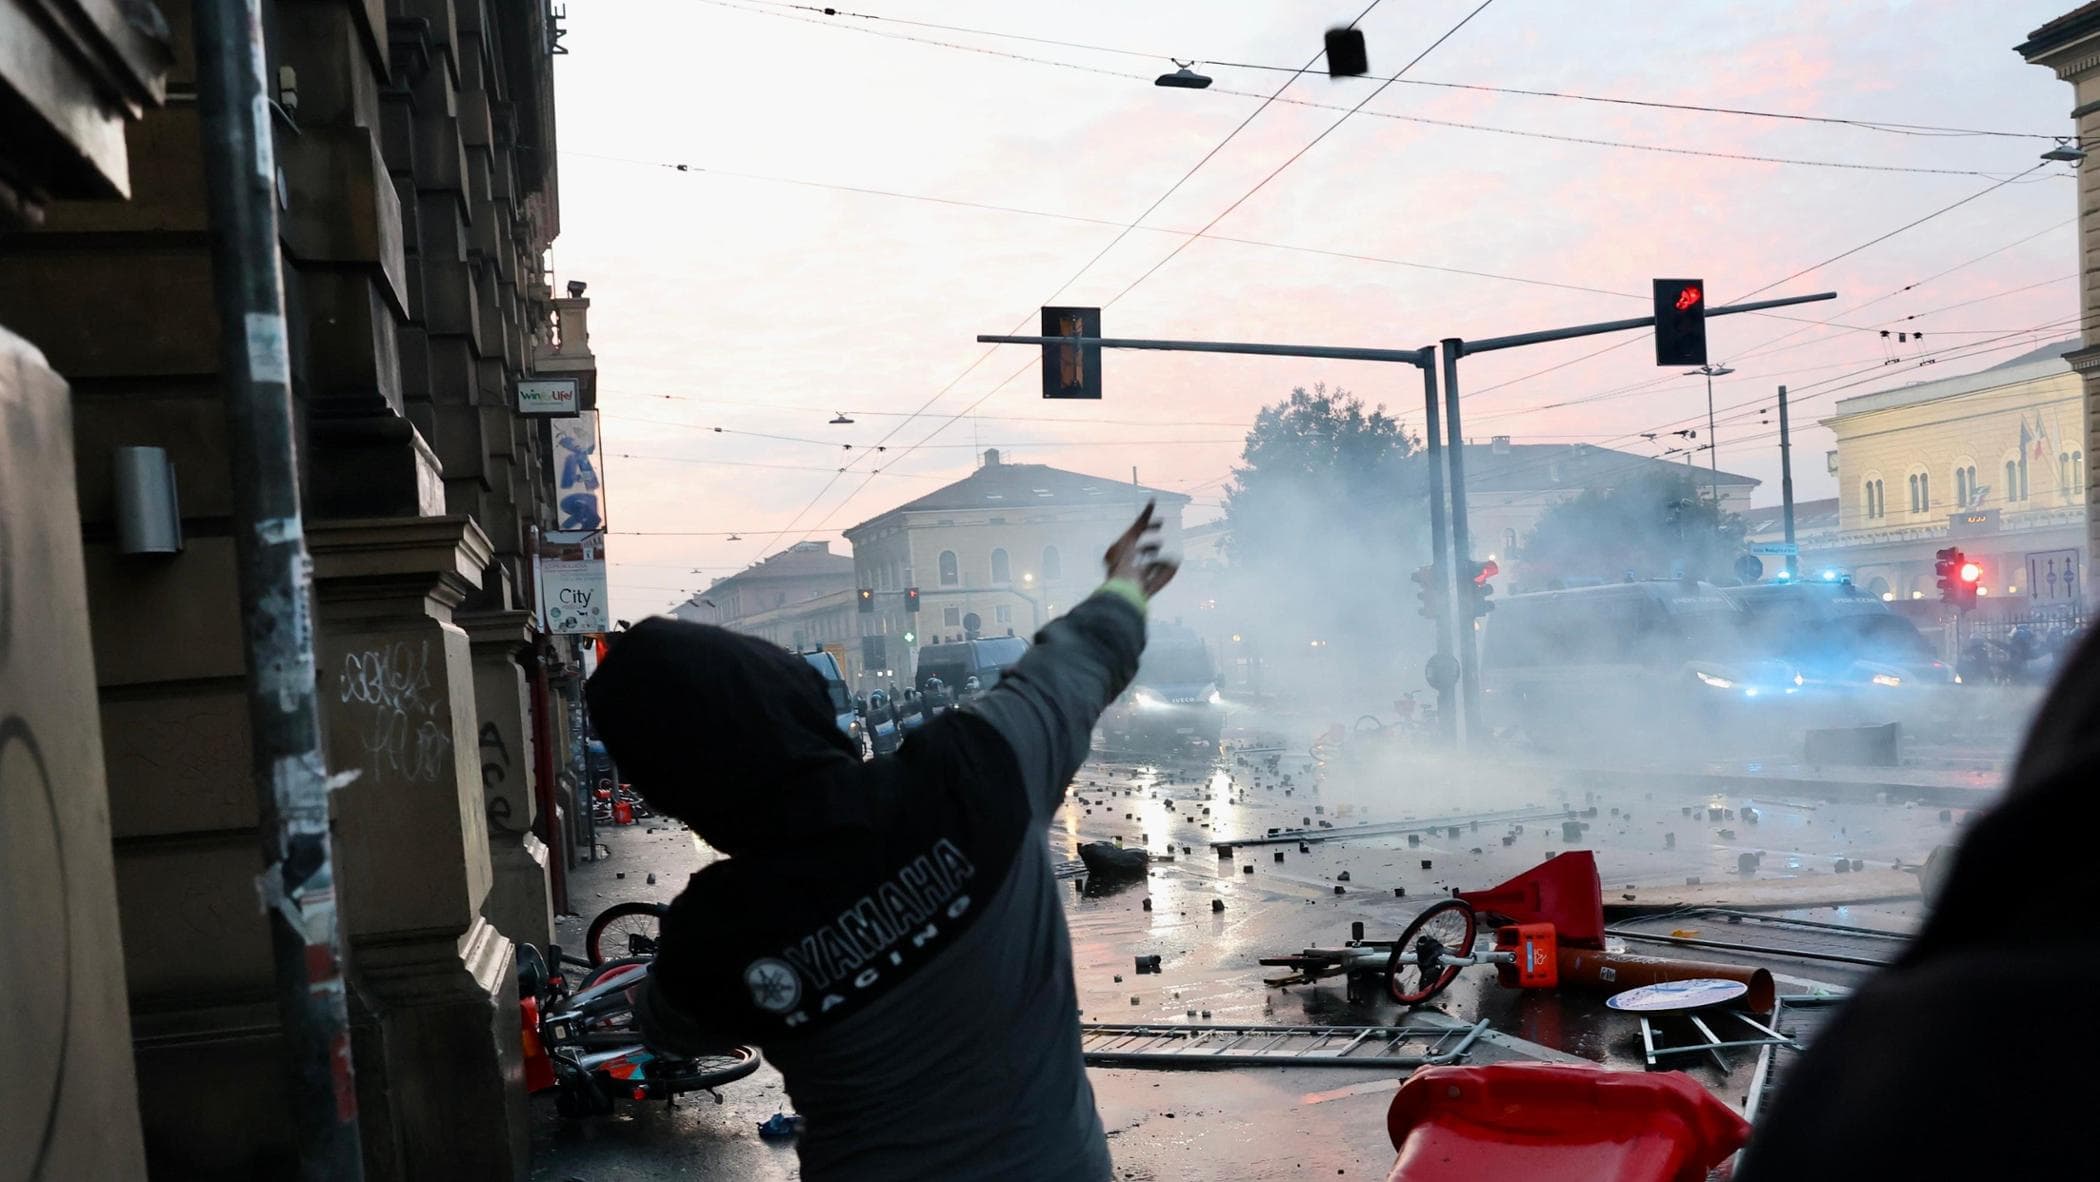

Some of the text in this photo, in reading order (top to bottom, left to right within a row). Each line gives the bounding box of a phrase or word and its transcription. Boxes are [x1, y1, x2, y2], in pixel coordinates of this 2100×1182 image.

[560, 588, 592, 608] City
[783, 837, 976, 990] YAMAHA
[785, 895, 972, 1028] RACING
